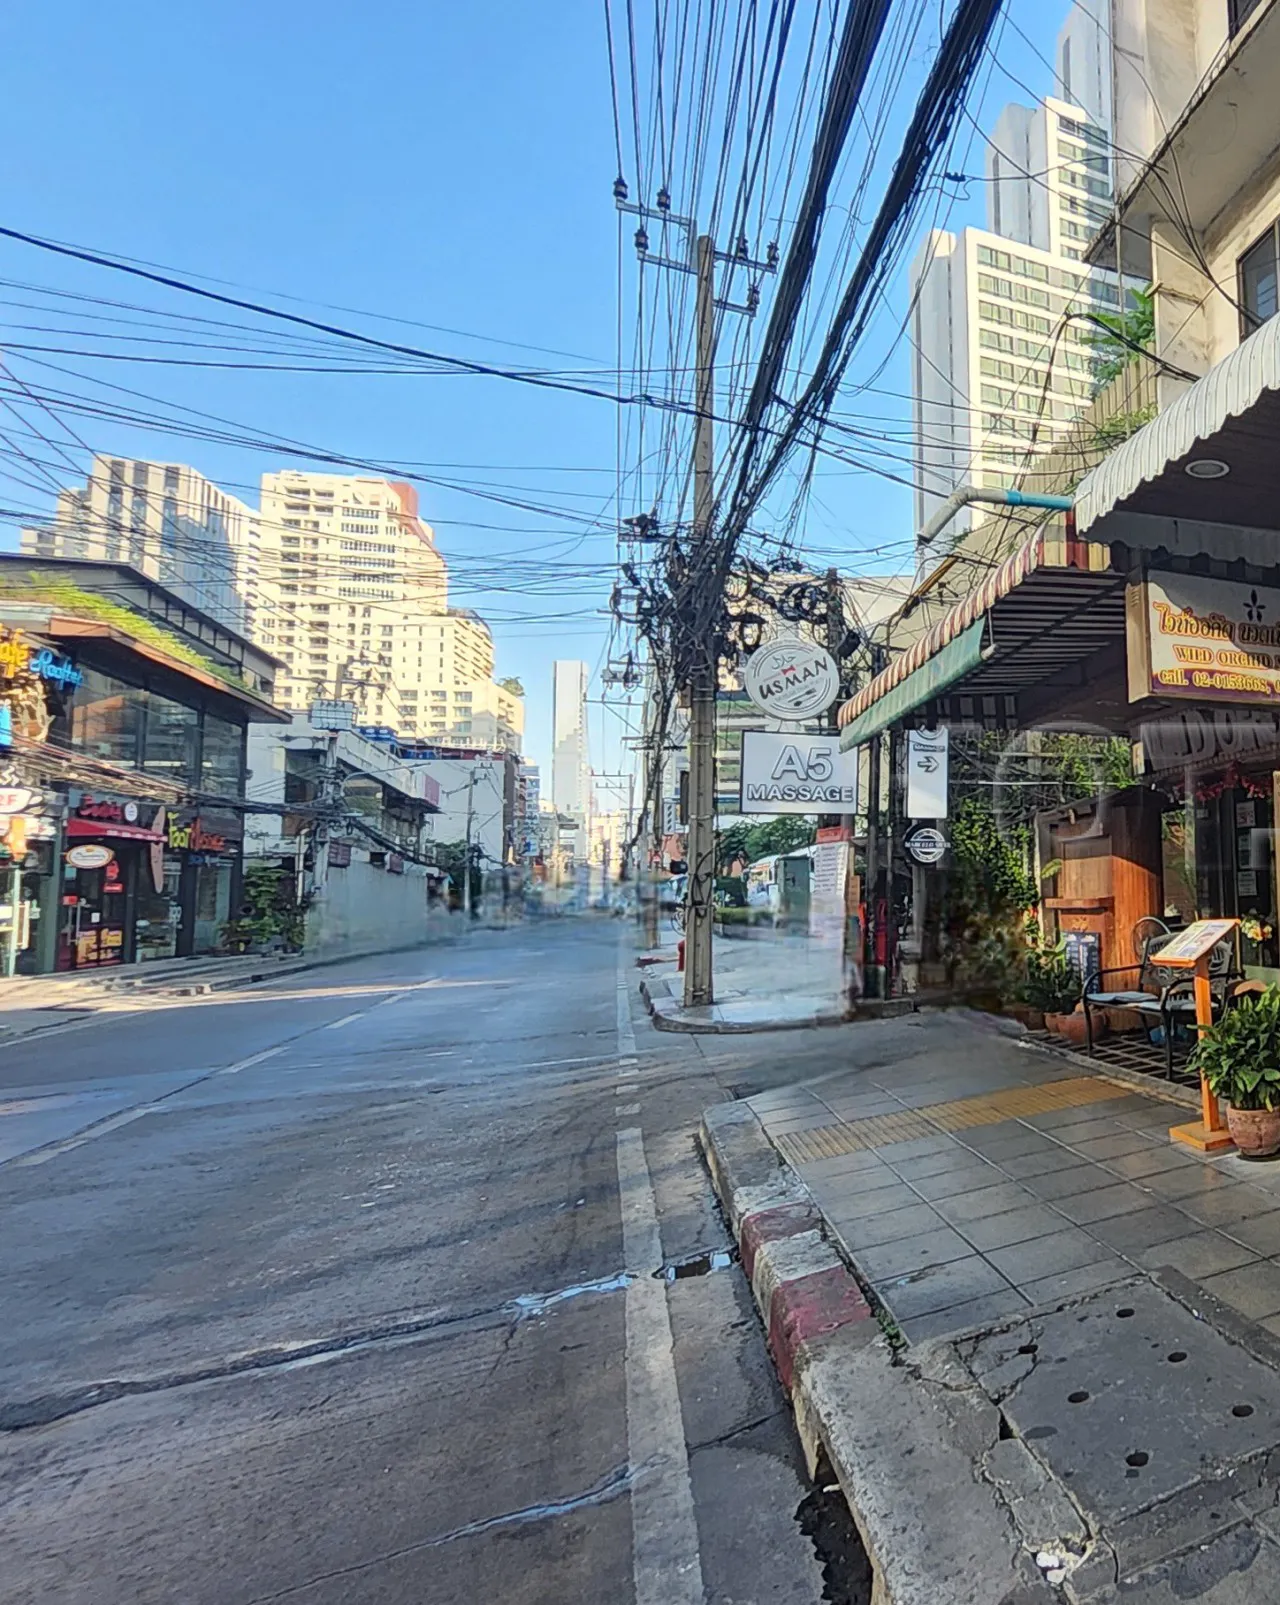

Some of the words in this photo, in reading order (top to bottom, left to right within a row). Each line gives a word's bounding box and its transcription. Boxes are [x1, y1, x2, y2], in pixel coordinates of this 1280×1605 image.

[1173, 645, 1214, 664] WILD
[1217, 650, 1273, 671] ORCHID
[759, 657, 828, 699] USMAN
[771, 745, 833, 782] A5
[747, 784, 854, 802] MASSAGE
